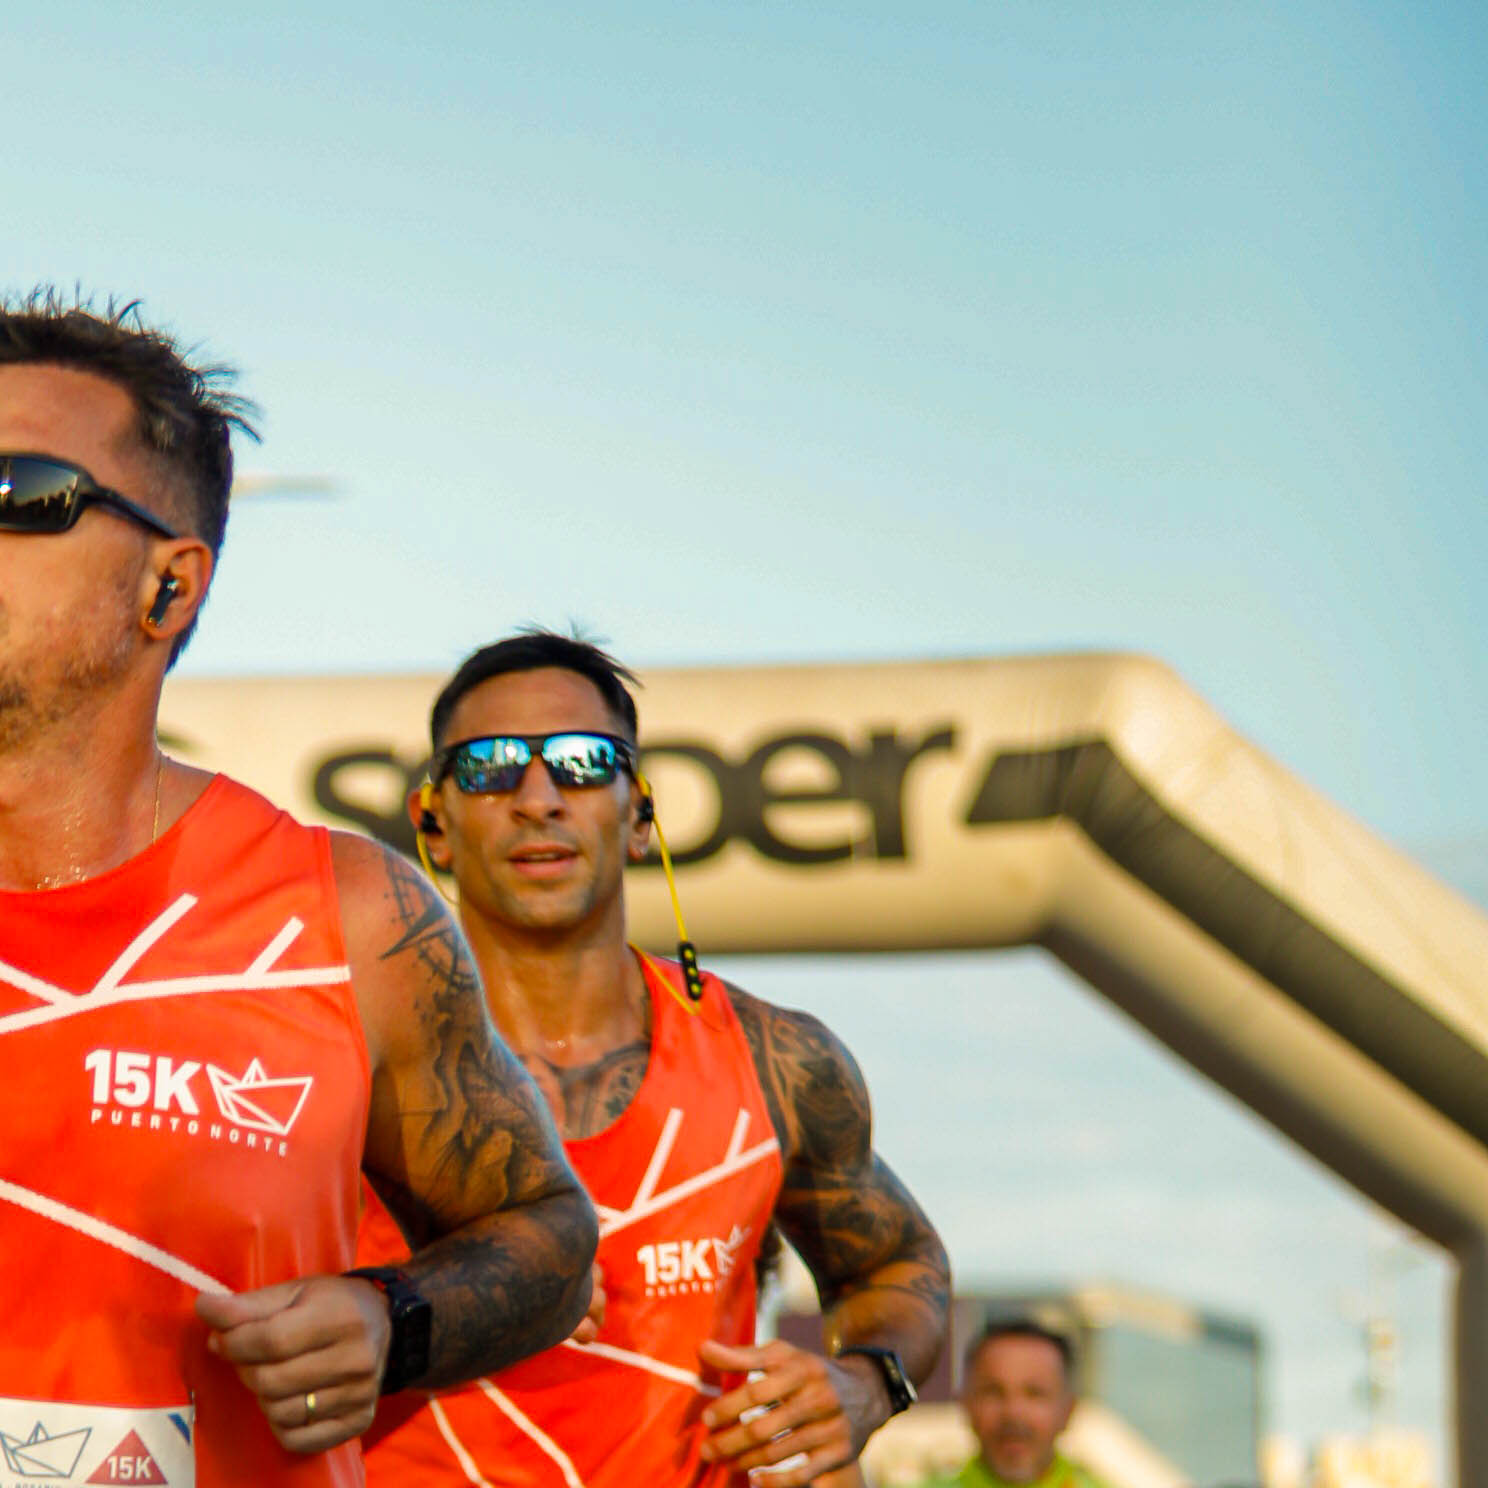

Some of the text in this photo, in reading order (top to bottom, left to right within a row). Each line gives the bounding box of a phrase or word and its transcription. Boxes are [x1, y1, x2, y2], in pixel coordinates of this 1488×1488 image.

[84, 1048, 202, 1116] 15K
[90, 1108, 288, 1157] PUERTO NORTE
[637, 1238, 714, 1286] 15K
[107, 1455, 153, 1480] 15K
